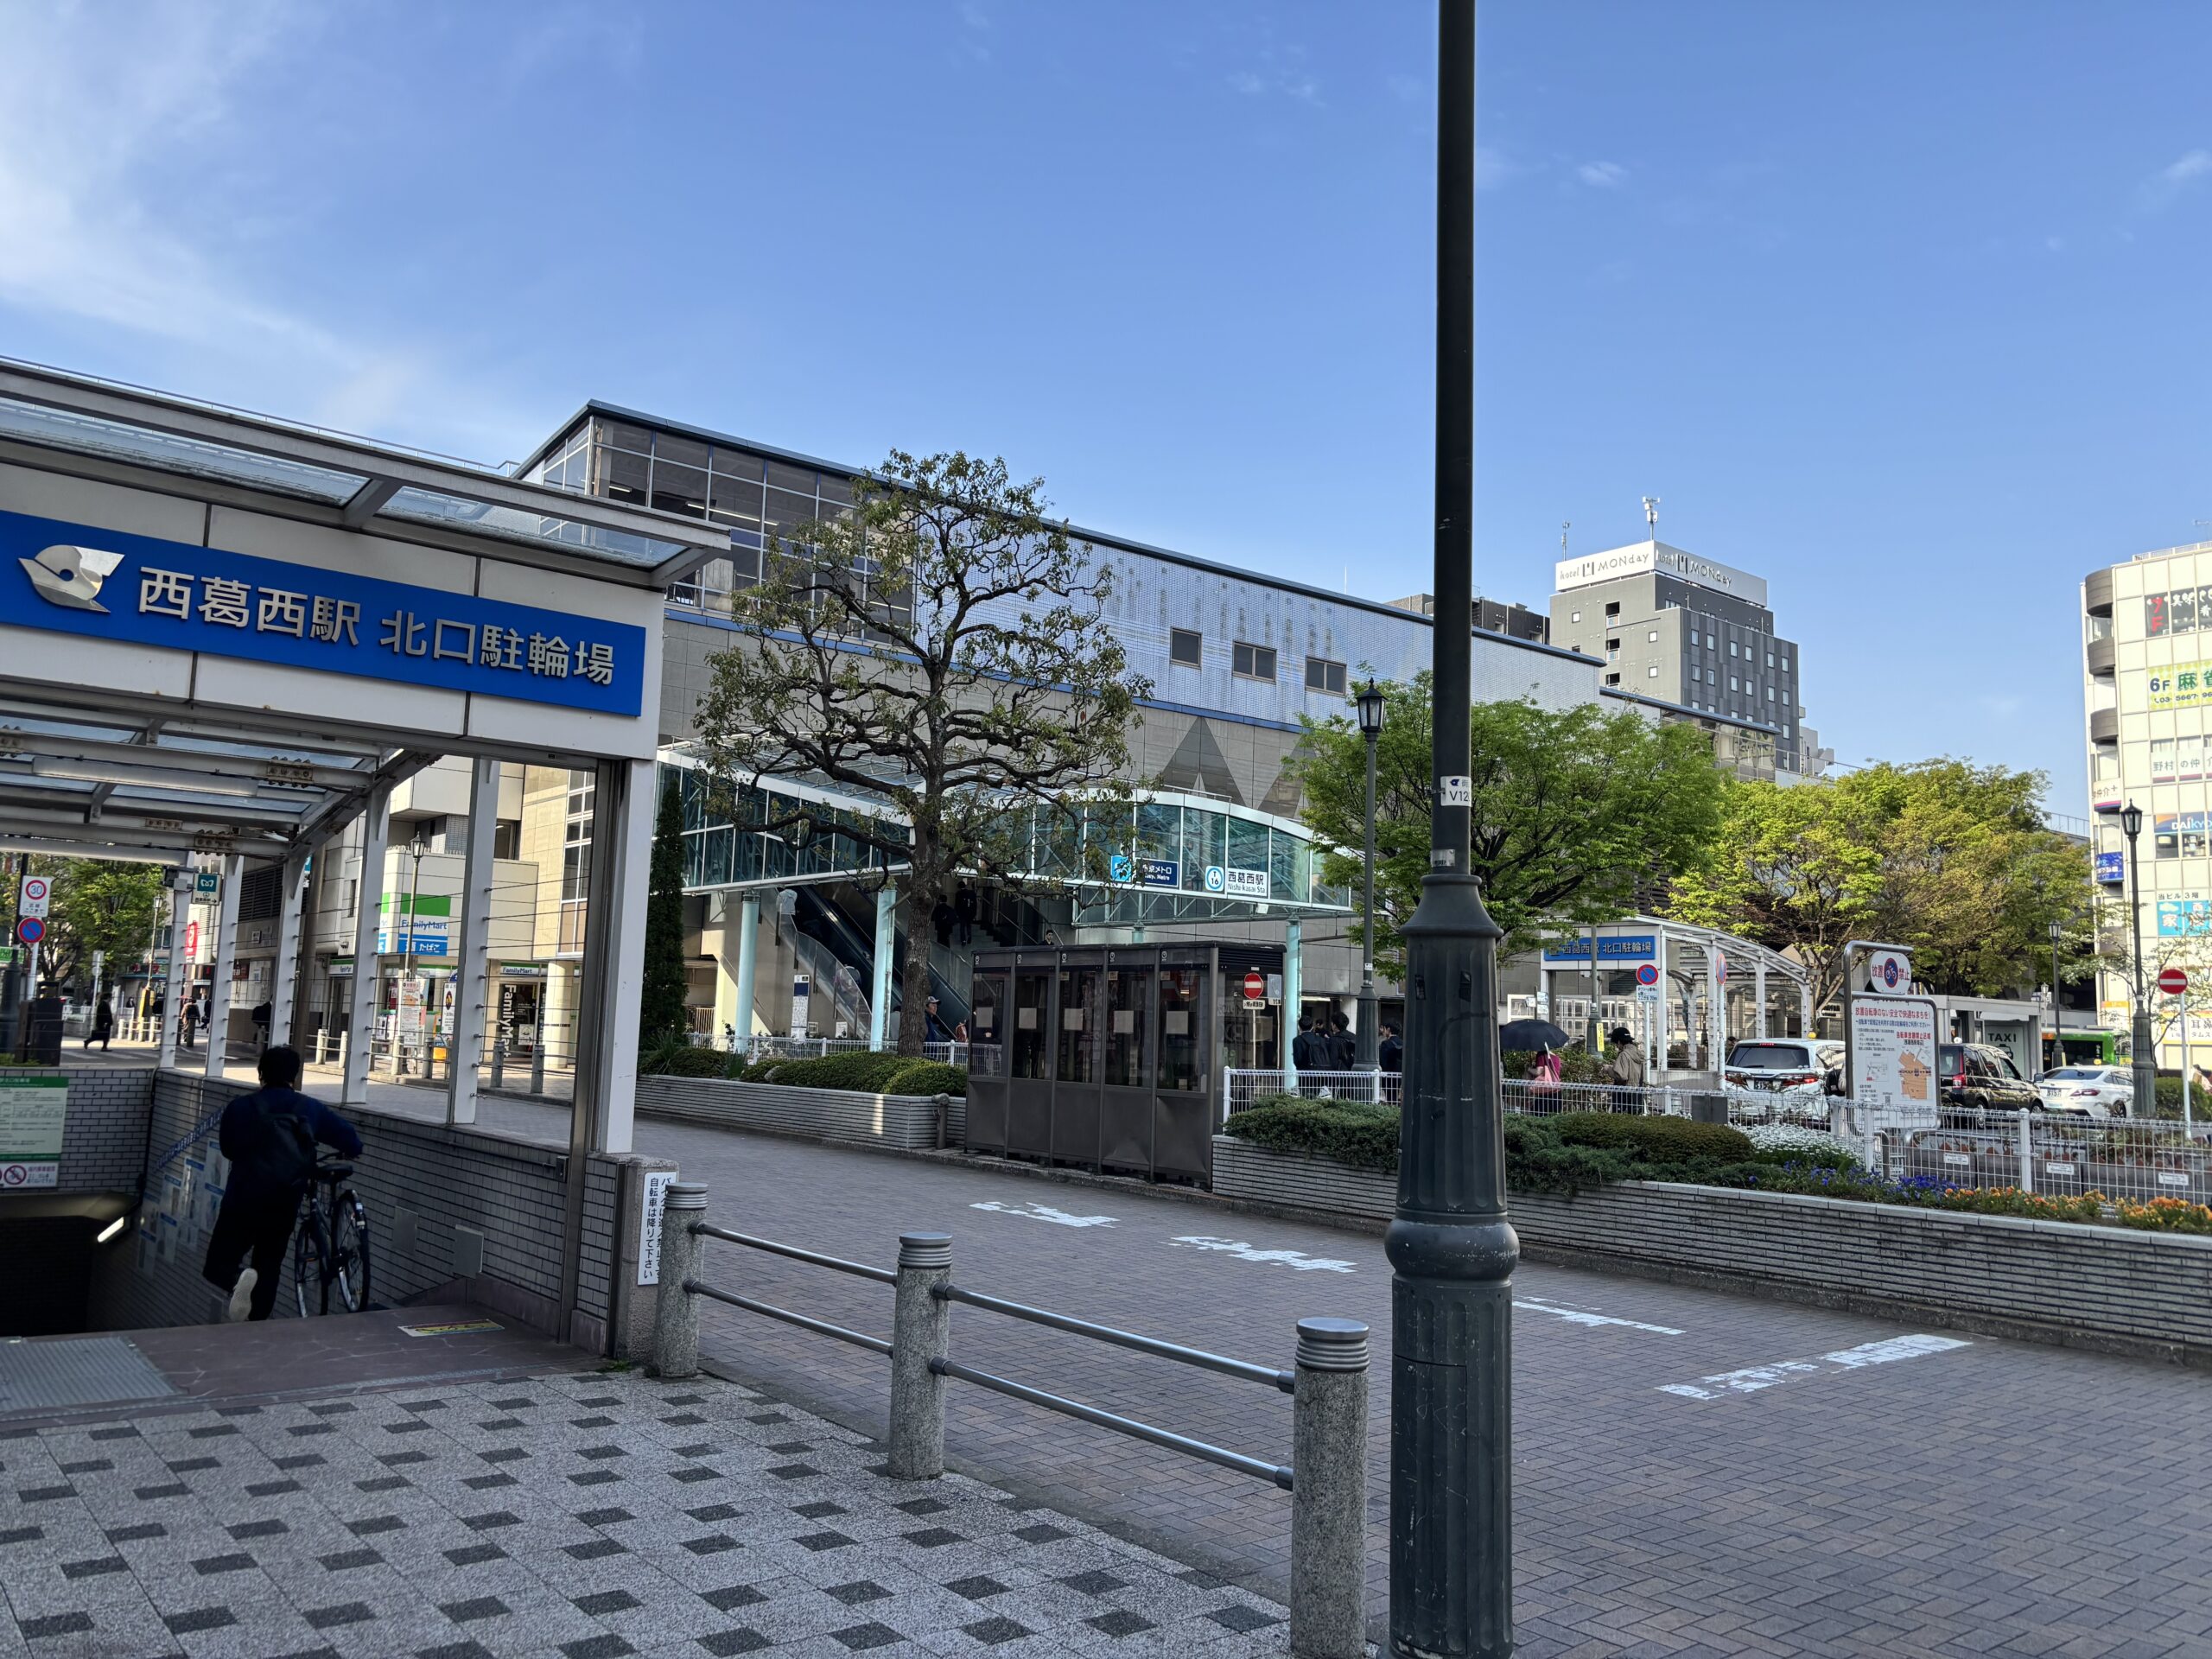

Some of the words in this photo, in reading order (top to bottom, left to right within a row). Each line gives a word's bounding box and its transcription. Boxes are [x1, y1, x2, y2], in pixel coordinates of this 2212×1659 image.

[1560, 566, 1580, 580] hotel
[139, 566, 361, 646] 西葛西駅
[379, 610, 615, 686] 北口駐輪場
[1228, 871, 1264, 886] 西葛西駅
[30, 885, 43, 895] 30
[1603, 941, 1652, 954] 北口駐輪場
[1872, 964, 1884, 978] 放置
[1898, 968, 1910, 981] 禁止
[1987, 1033, 2017, 1043] TAXI
[643, 1178, 659, 1279] 自転車は降りて下さい
